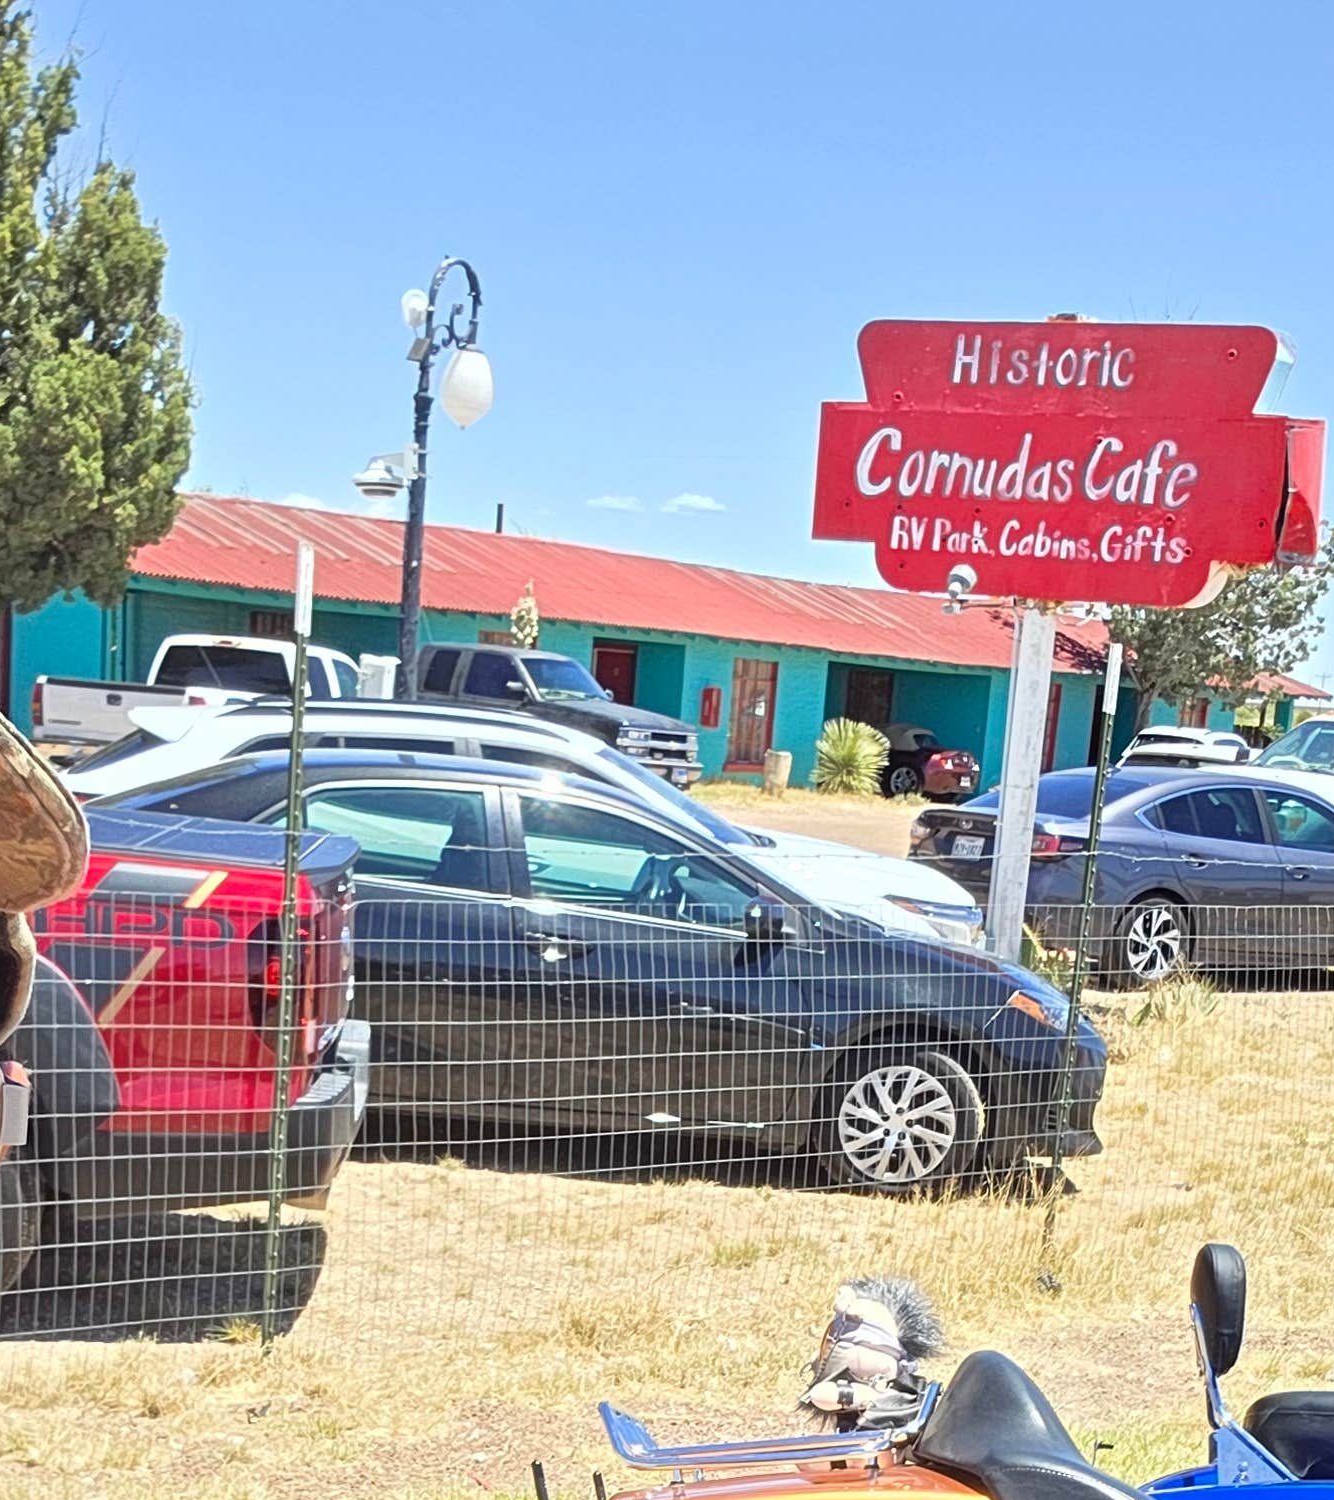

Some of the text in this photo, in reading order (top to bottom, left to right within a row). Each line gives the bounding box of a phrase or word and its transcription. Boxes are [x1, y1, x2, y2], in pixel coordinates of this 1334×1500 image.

[951, 333, 1136, 388] Historic
[855, 427, 1197, 509] Cornudas Cafe
[891, 516, 926, 551] RV
[1100, 526, 1185, 565] Gifts
